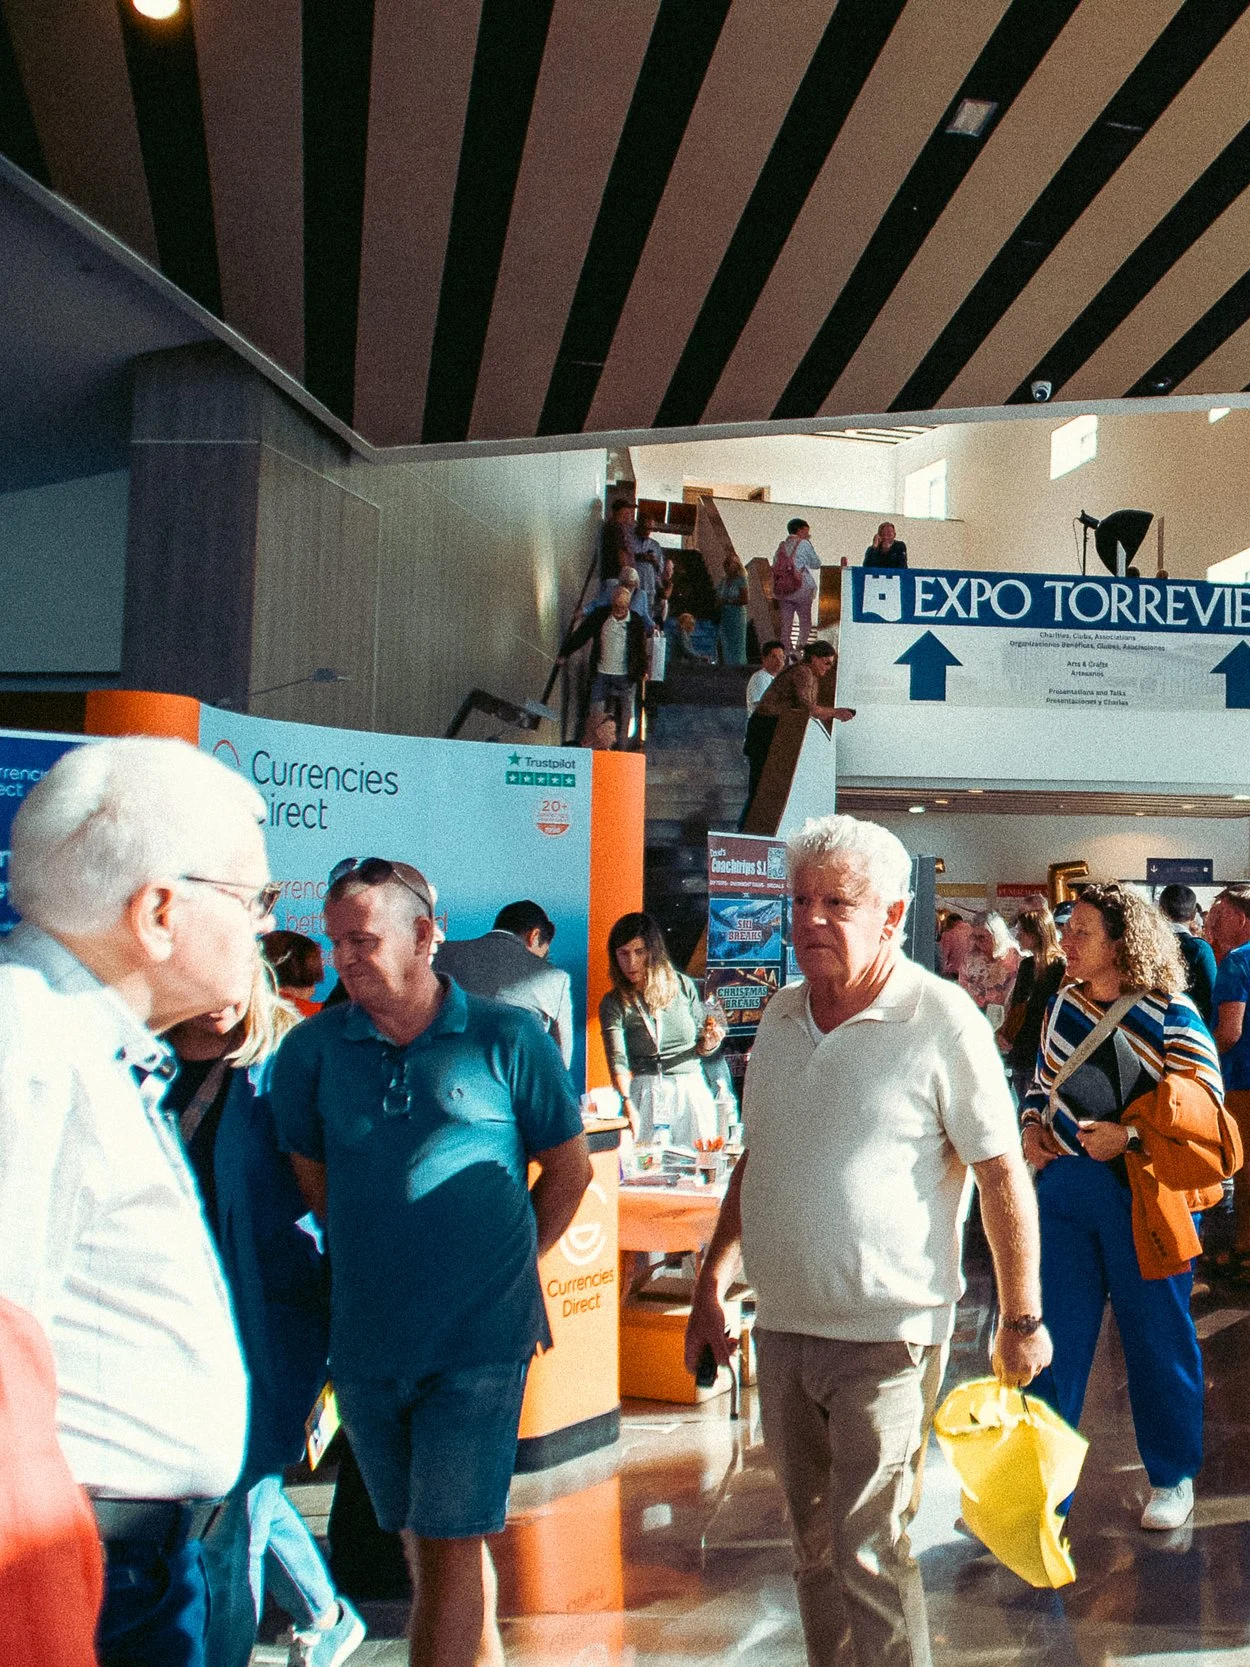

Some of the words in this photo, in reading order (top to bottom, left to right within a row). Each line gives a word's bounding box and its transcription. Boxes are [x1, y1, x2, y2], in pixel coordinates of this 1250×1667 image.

[913, 576, 1033, 622] EXPO
[1039, 631, 1071, 640] Charities,
[1072, 633, 1094, 641] Clubs,
[1094, 633, 1136, 642] Associations
[1066, 660, 1081, 668] Arts
[1088, 661, 1109, 669] Crafts
[1048, 688, 1095, 697] Presentations
[1096, 689, 1109, 697] and
[1110, 689, 1126, 697] Talks
[1046, 697, 1097, 706] Presentaciones
[524, 756, 576, 770] Trustpilot
[252, 750, 399, 796] Currencies
[258, 794, 328, 830] irect
[542, 800, 568, 812] 20+
[711, 857, 755, 876] Coachtrips
[737, 919, 753, 930] SKI
[728, 930, 763, 942] BREAKS
[717, 985, 769, 998] CHRISTMAS
[724, 998, 761, 1010] BREAKS
[546, 1268, 614, 1298] Currencies
[562, 1293, 601, 1319] Direct
